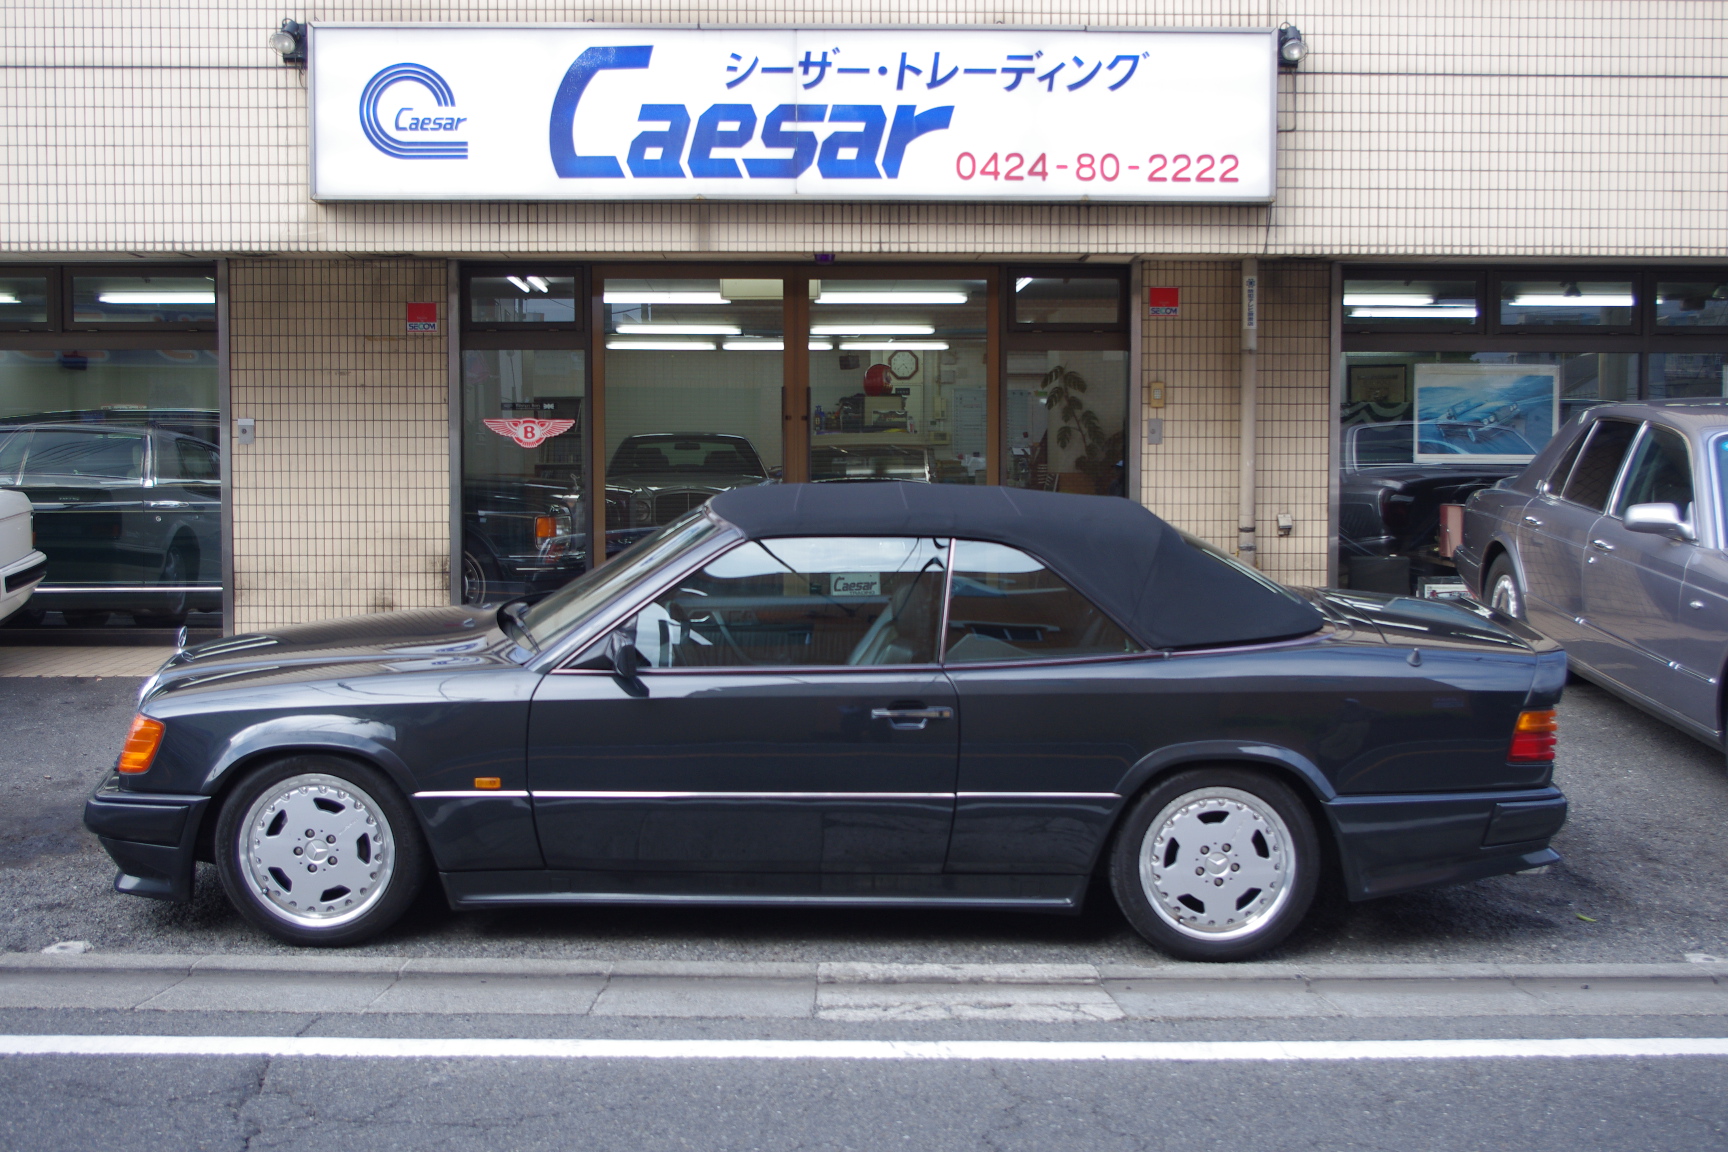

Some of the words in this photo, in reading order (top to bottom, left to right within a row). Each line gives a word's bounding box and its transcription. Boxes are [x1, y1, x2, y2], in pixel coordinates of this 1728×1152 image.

[726, 47, 1150, 91] シーザー・トレーディング
[395, 107, 468, 131] Caesar
[550, 45, 956, 178] Caesar
[956, 152, 1240, 182] 0424-80-2222
[1150, 307, 1177, 315] SECOM
[524, 425, 535, 439] B
[833, 576, 877, 592] Caesar
